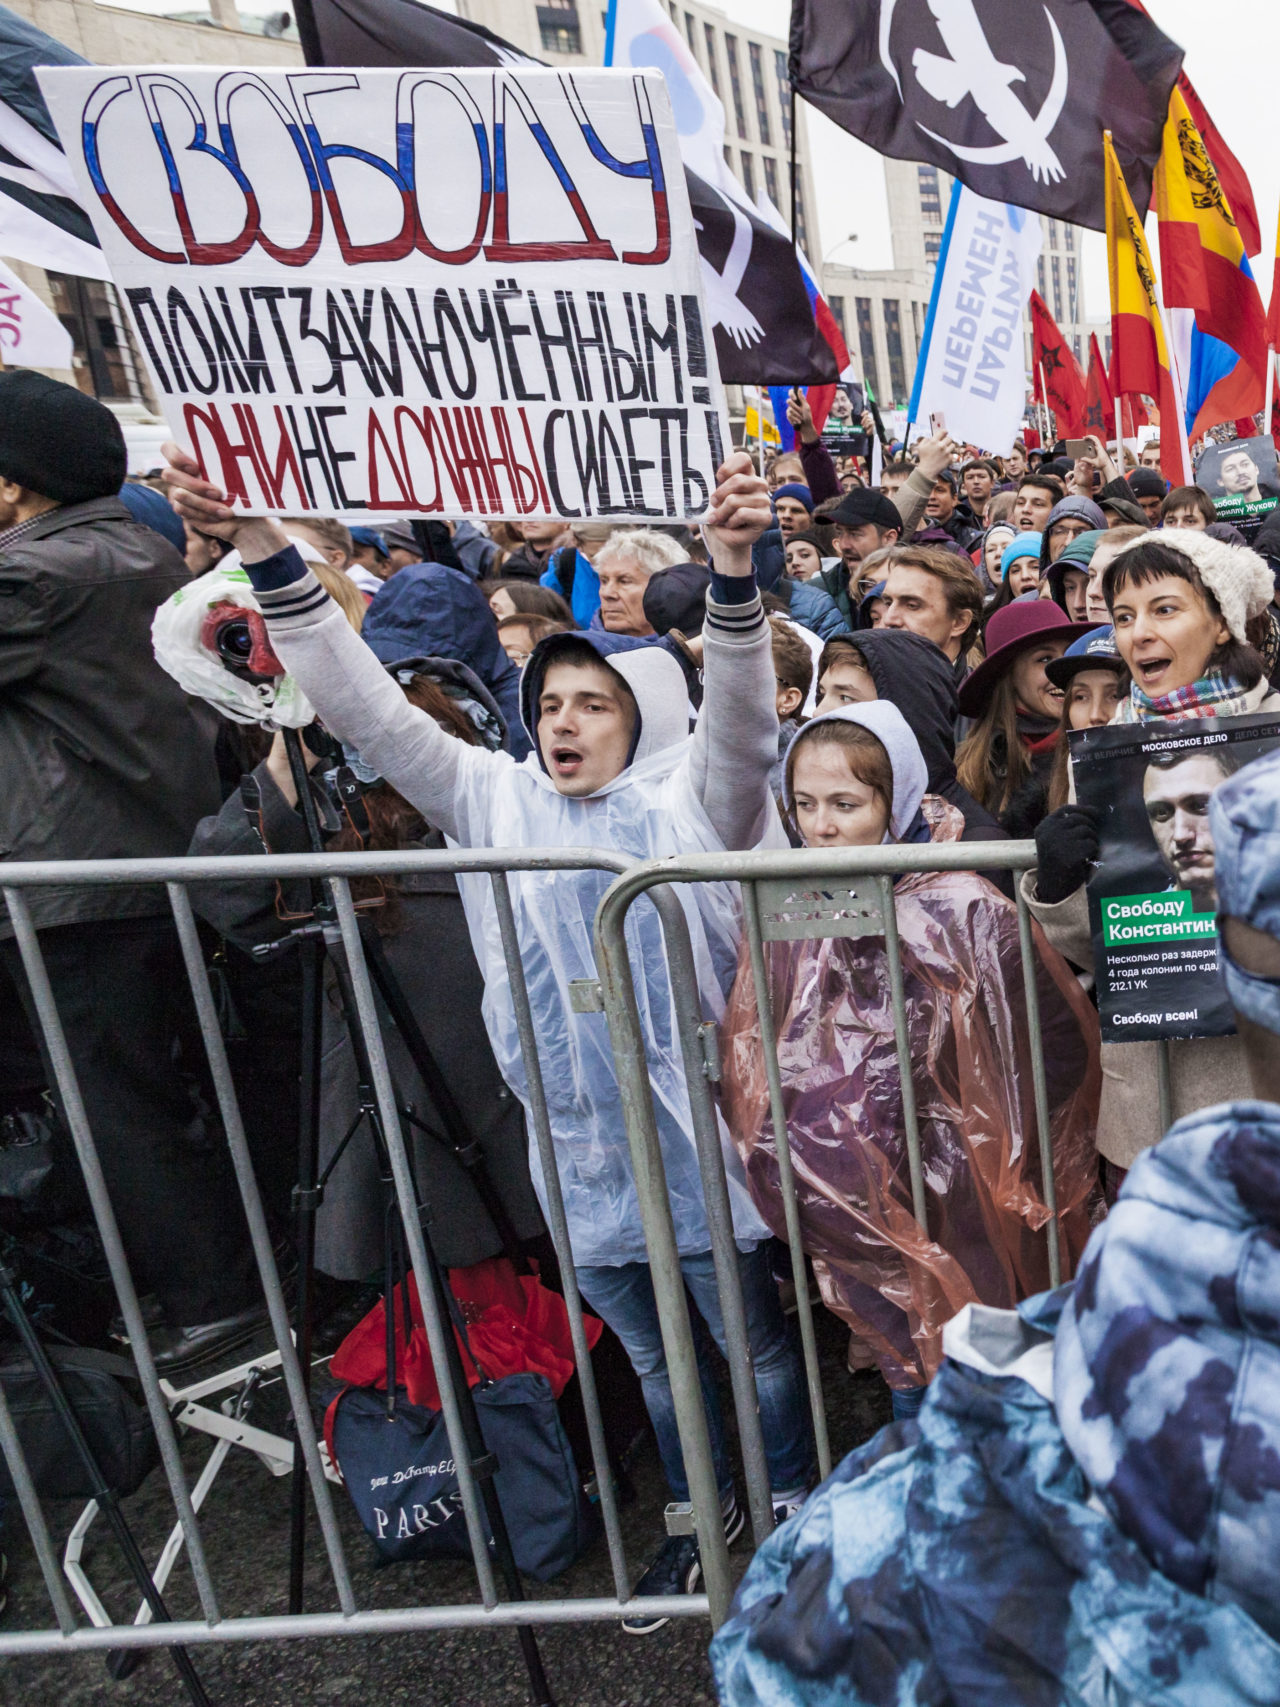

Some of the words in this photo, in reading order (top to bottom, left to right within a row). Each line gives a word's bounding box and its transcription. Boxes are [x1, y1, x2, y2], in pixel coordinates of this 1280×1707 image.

[82, 71, 671, 267] СВОБОДУ
[124, 278, 711, 405] ПОЛИТЗАКЛЮЧЁННЫМ!
[183, 402, 310, 510] ОНИ
[285, 405, 367, 510] НЕ
[366, 404, 551, 514] ДОЛЖНЫ
[1214, 497, 1242, 509] вободу
[1216, 507, 1244, 517] ириллу
[1245, 500, 1276, 513] Жукову
[1141, 736, 1202, 753] МОСКОВСКОЕ
[1203, 733, 1228, 746] ДЕЛО
[1107, 900, 1185, 919] Свободу
[1109, 919, 1216, 940] Константин
[1107, 952, 1159, 965] Несколько
[1162, 950, 1178, 961] раз
[1181, 949, 1217, 959] задерж
[1108, 969, 1115, 977] 4
[1117, 968, 1139, 978] года
[1142, 965, 1182, 975] колонии
[1185, 963, 1197, 972] по
[1109, 981, 1132, 991] 212.1
[1134, 979, 1148, 989] УК
[1112, 1013, 1162, 1025] Свободу
[1165, 1009, 1198, 1022] всем!
